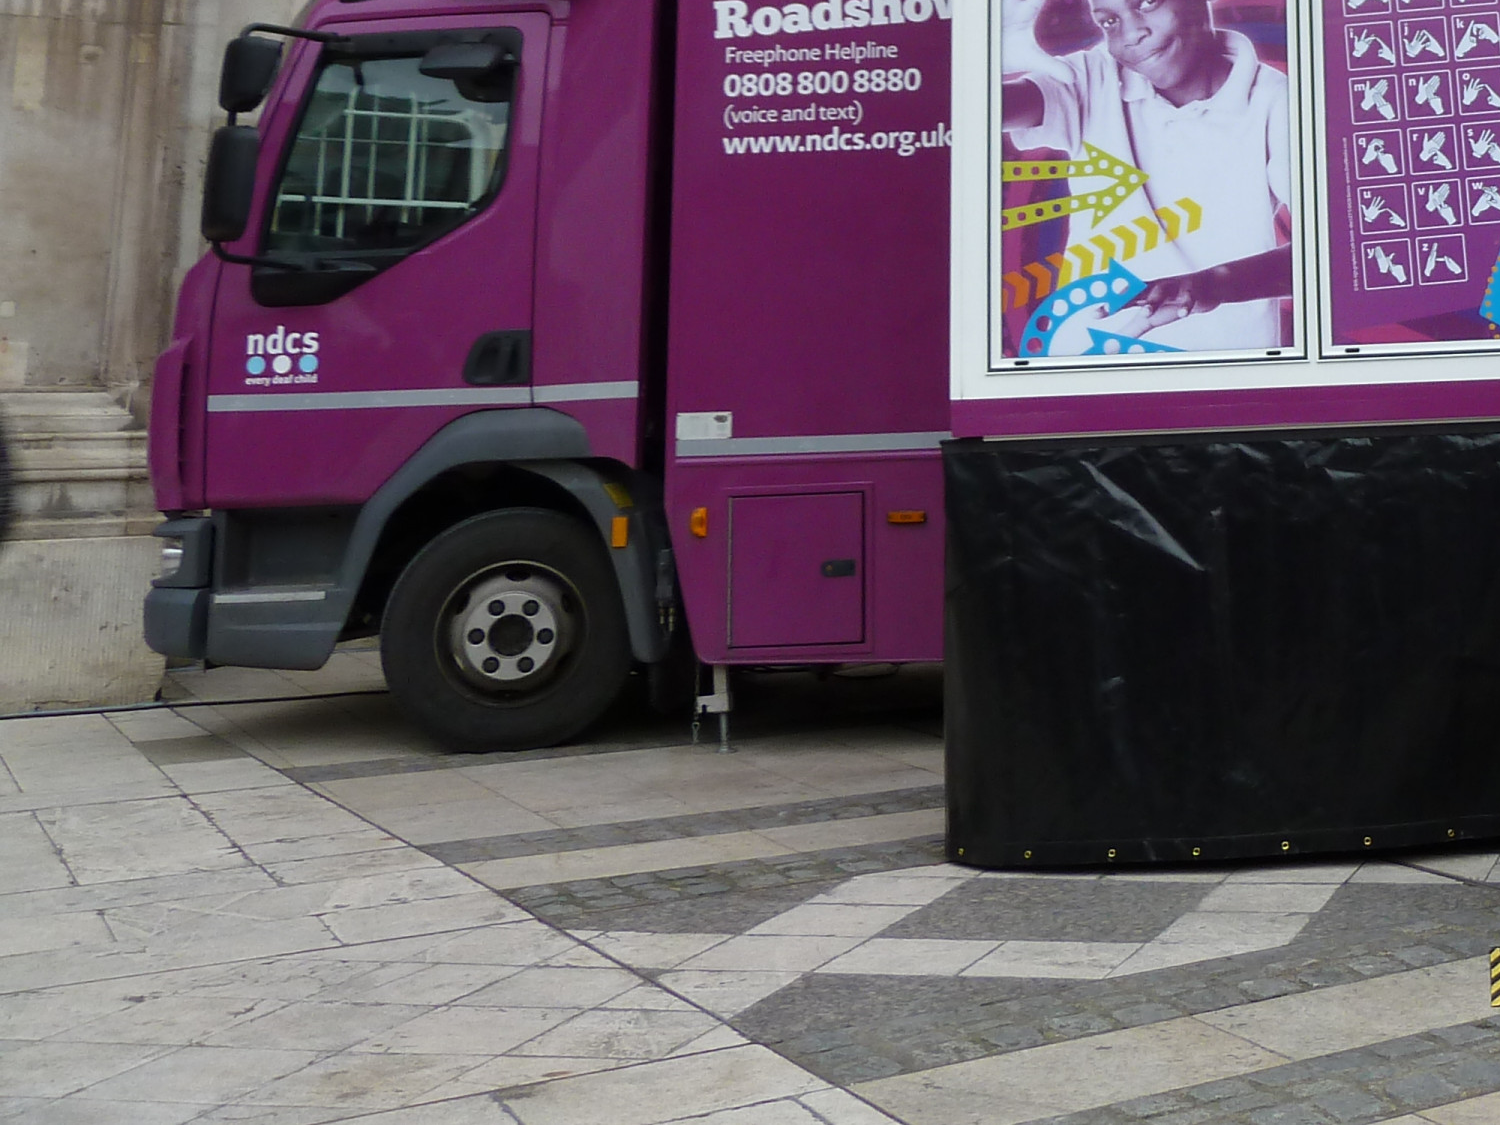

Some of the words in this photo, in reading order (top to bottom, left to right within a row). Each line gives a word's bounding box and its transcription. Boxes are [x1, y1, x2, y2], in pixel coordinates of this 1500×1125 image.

[725, 44, 821, 67] Freephone
[825, 41, 898, 63] Helpline
[723, 72, 792, 97] 0808
[797, 71, 849, 94] 800
[853, 68, 922, 93] 8880
[723, 104, 778, 129] (voice
[781, 102, 816, 122] and
[819, 100, 864, 125] text)
[247, 325, 319, 355] ndcs
[272, 375, 293, 384] deaf
[294, 374, 318, 383] child
